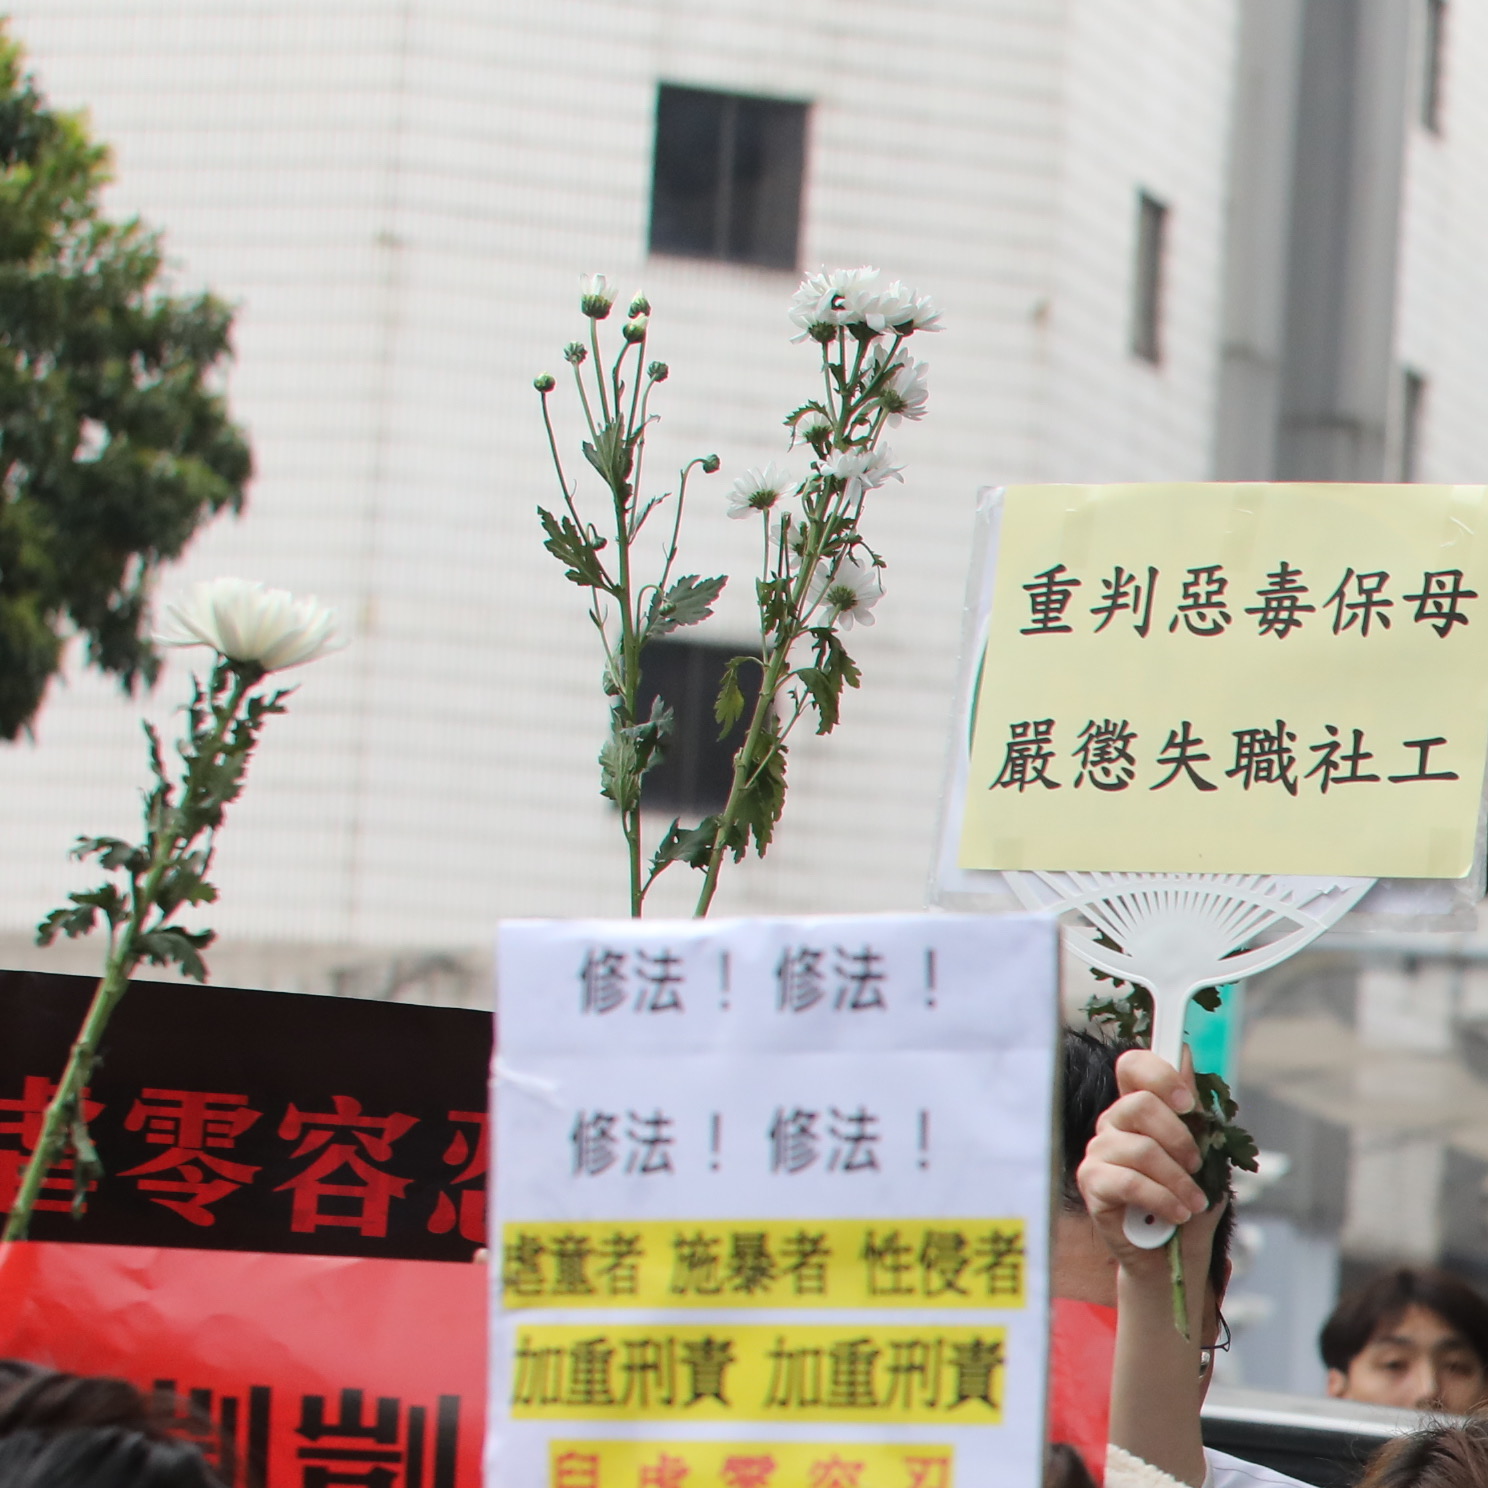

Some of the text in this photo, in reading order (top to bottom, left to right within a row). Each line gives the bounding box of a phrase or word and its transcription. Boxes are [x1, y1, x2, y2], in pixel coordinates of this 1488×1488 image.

[1018, 561, 1478, 639] 重判惡毒保母
[988, 718, 1460, 796] 嚴懲失職社工
[670, 1230, 831, 1298] 施暴者
[860, 1229, 1026, 1298] 性侵者
[513, 1334, 1006, 1412] 加重刑責 加重刑責
